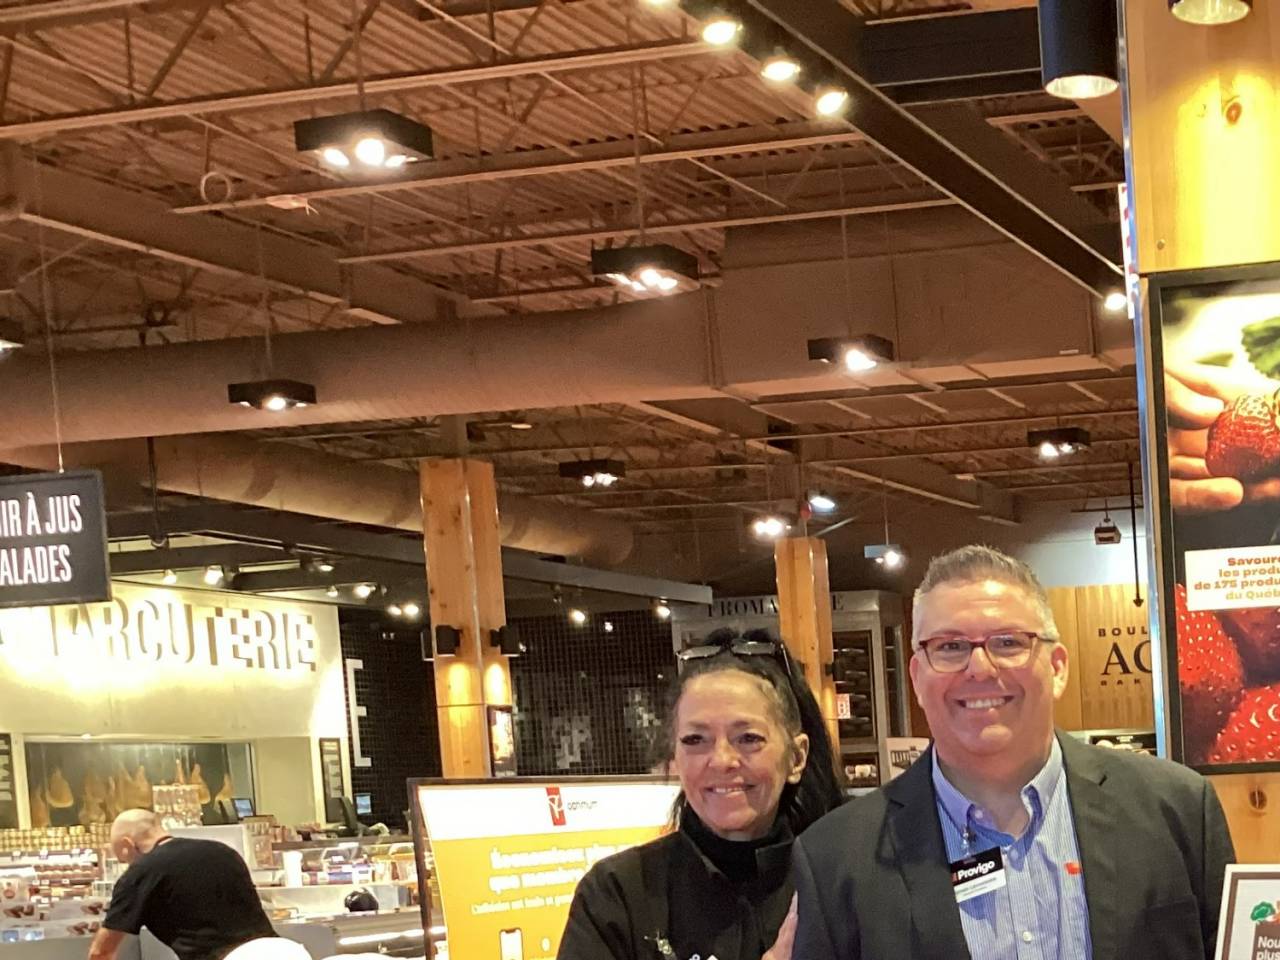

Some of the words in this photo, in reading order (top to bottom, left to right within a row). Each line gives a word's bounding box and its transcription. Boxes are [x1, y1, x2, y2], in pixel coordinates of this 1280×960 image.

[0, 499, 22, 537] IR
[26, 491, 42, 536] À
[45, 494, 82, 534] JUS
[1218, 568, 1240, 578] les
[1194, 580, 1211, 590] de
[1214, 579, 1237, 589] 175
[1226, 590, 1242, 600] du
[957, 860, 995, 881] Provigo
